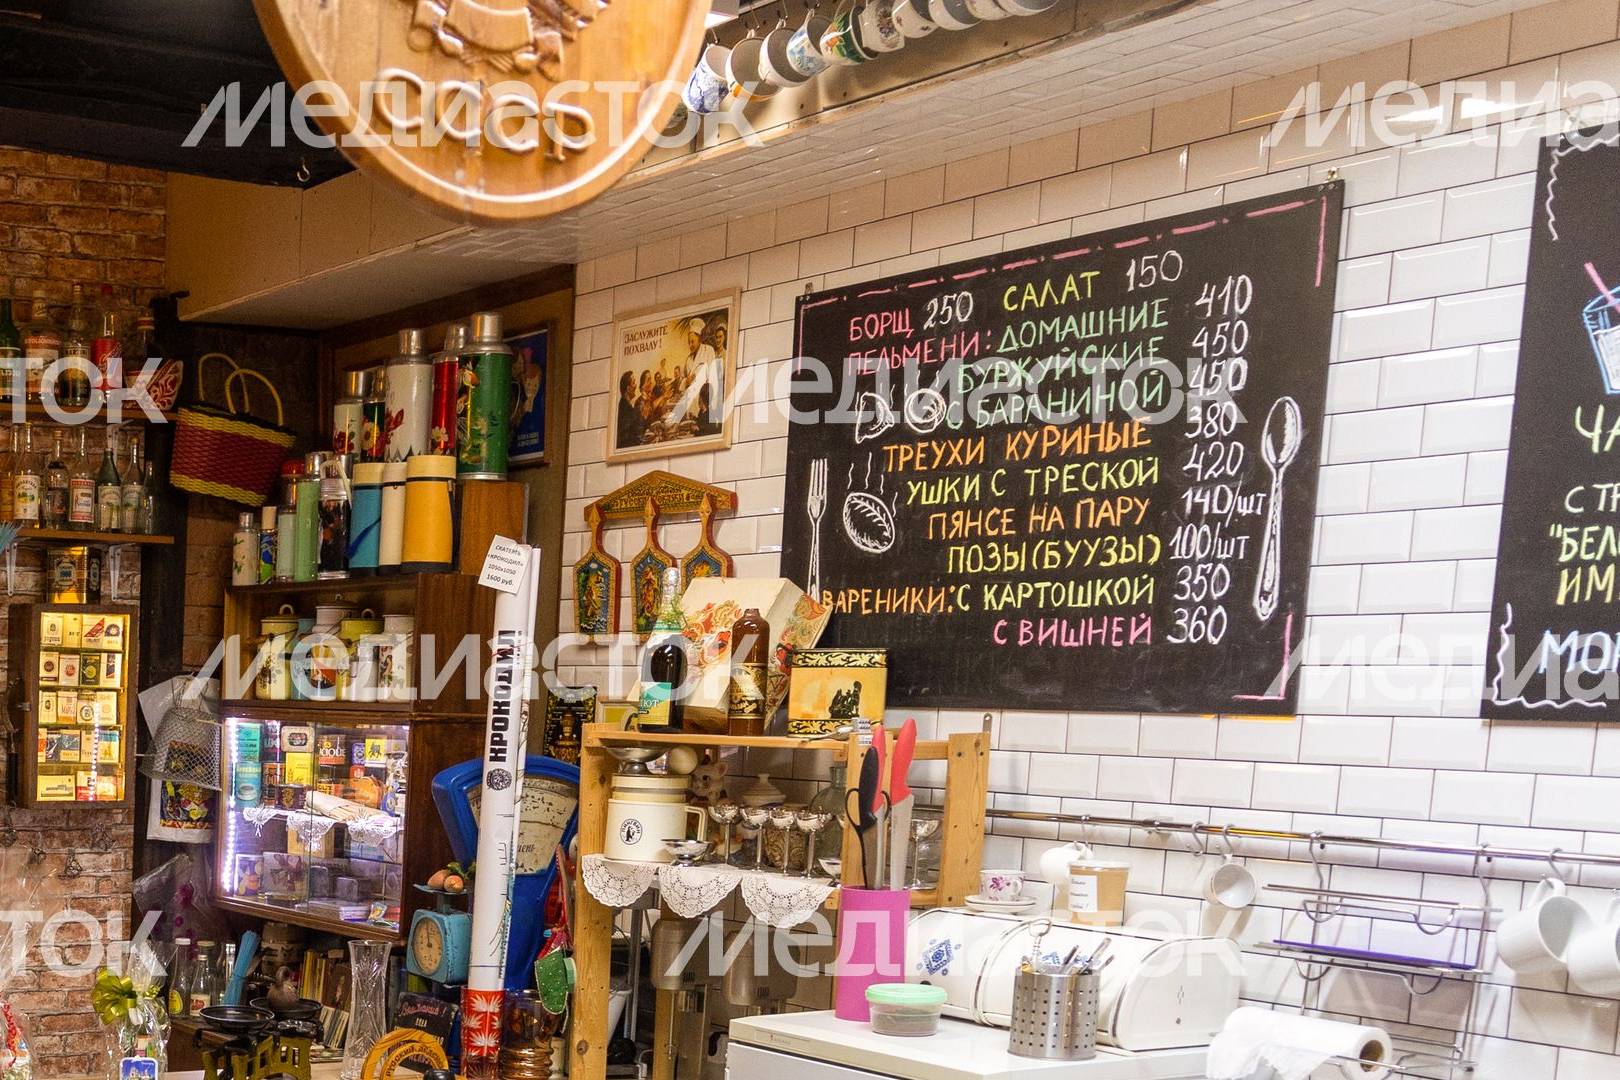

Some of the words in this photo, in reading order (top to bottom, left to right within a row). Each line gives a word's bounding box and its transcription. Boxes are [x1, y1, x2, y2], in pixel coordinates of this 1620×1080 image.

[374, 67, 594, 162] СССР
[1003, 270, 1100, 311] САЛАТ
[1126, 250, 1183, 292] 150
[623, 323, 670, 345] ЗАСЛУЖИТЕ
[849, 307, 914, 342] БОРЩ
[923, 291, 974, 331] 250
[997, 297, 1169, 353] ДОМАШНИЕ
[1194, 274, 1253, 318] 410
[623, 339, 664, 357] ПОХВАЛУ!
[957, 336, 1169, 395] БУРЖУЙСКИЕ
[1192, 320, 1249, 358] 450
[945, 400, 962, 430] С
[976, 369, 1165, 429] БАРАНИНОЙ
[1189, 357, 1249, 396] 450
[882, 436, 985, 473] ТРЕУХИ
[1006, 416, 1153, 461] КУРИНЫЕ
[1184, 402, 1238, 439] 380
[906, 473, 981, 506] УШКИ
[991, 468, 1006, 497] С
[1024, 456, 1160, 497] ТРЕСКОЙ
[1181, 441, 1245, 480] 420
[928, 508, 1017, 540] ПЯНСЕ
[1028, 503, 1065, 534] НА
[1075, 496, 1150, 530] ПАРУ
[1564, 485, 1585, 513] С
[487, 553, 524, 568] «КРОКОДИЛ»
[495, 544, 522, 557] СКАТЕРТЬ
[486, 572, 502, 583] 1600
[501, 576, 515, 587] руб.
[956, 584, 971, 611] С
[982, 573, 1155, 612] КАРТОШКОЙ
[1173, 564, 1231, 602] 350
[993, 618, 1008, 646] С
[1018, 613, 1152, 648] ВИШНЕЙ
[1165, 607, 1228, 646] 360
[488, 630, 517, 763] КРОКОДИЛ
